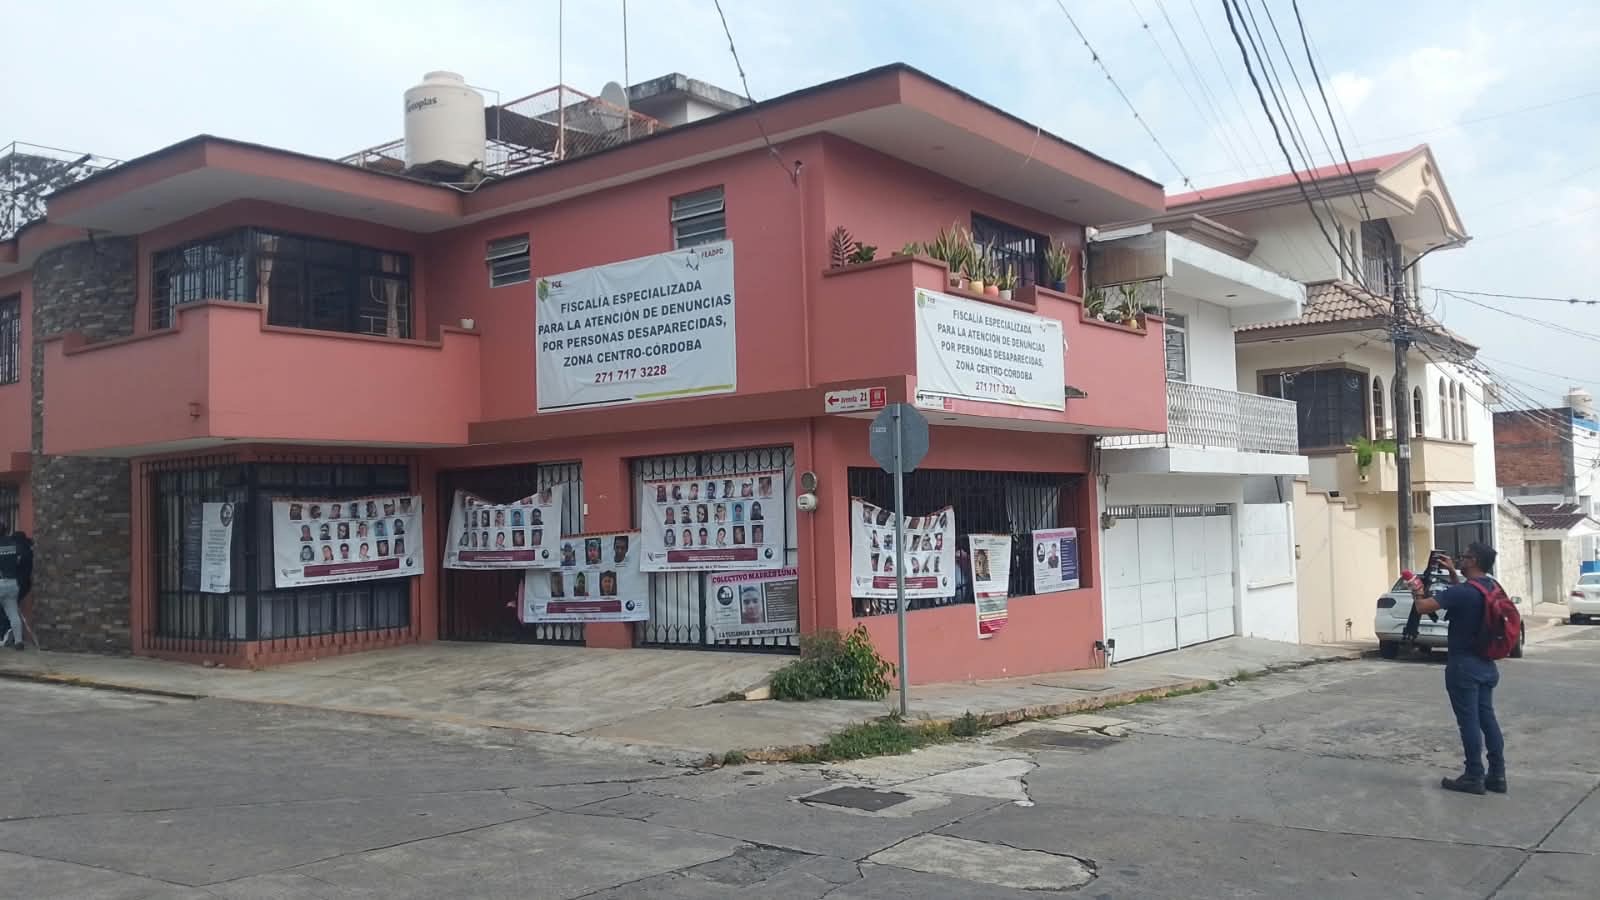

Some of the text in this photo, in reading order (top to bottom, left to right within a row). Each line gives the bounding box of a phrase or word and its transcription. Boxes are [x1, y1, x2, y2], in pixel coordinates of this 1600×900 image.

[561, 280, 702, 314] FISCALÍA ESPECIALIZADA
[538, 320, 564, 335] PARA
[567, 318, 581, 331] LA
[643, 306, 658, 318] DE
[662, 294, 732, 316] DENUNCIAS
[543, 315, 727, 352] POR PERSONAS DESAPARECIDAS,
[985, 317, 1032, 334] ESPECIALIZADA
[938, 323, 956, 335] PARA
[957, 327, 967, 337] LA
[1002, 336, 1011, 346] DE
[1011, 338, 1046, 353] DENUNCIAS
[941, 341, 955, 352] POR
[957, 344, 992, 359] PERSONAS
[564, 354, 593, 367] ZONA
[956, 360, 975, 371] ZONA
[595, 364, 667, 383] 271 717 3228
[976, 381, 987, 392] 271
[988, 383, 1000, 393] 717
[860, 391, 867, 402] 21
[712, 574, 748, 584] COLECTIVO
[777, 568, 797, 578] LUNA
